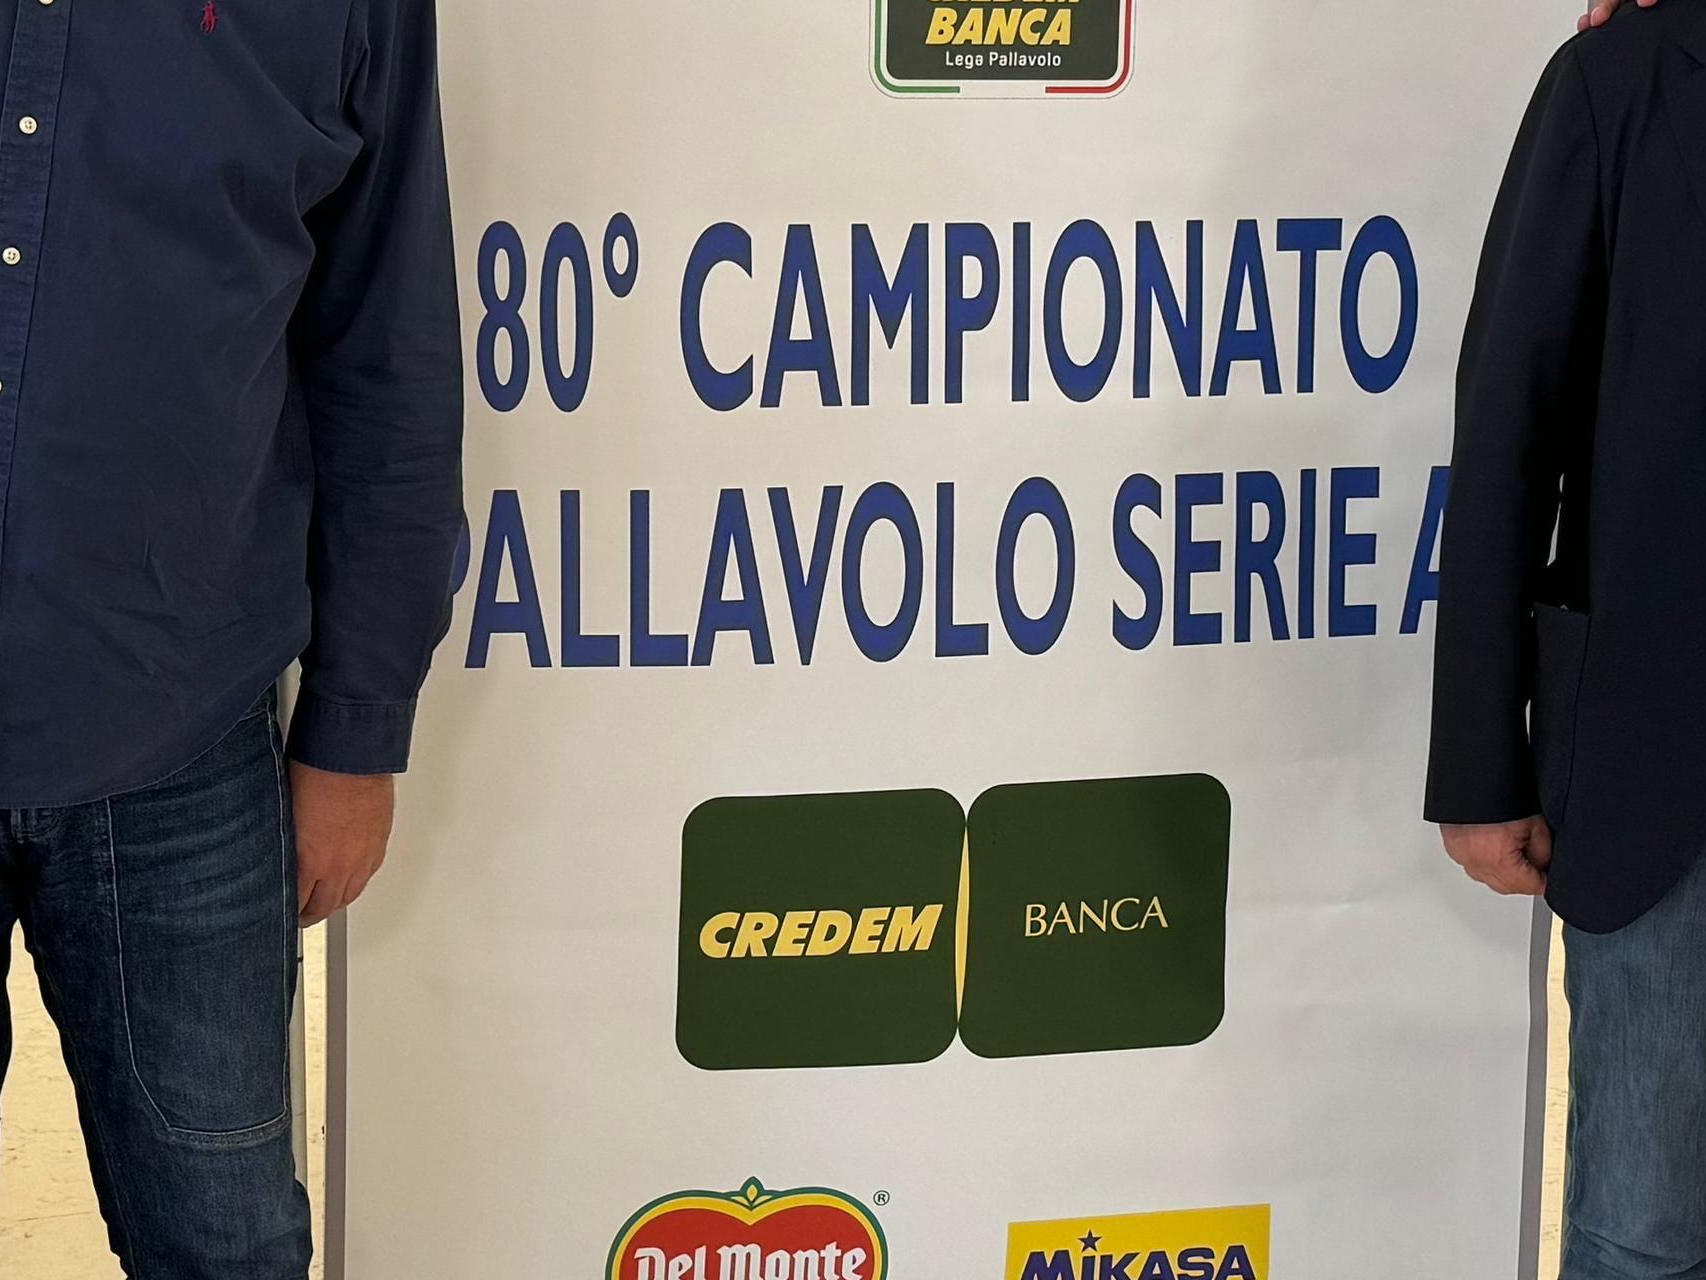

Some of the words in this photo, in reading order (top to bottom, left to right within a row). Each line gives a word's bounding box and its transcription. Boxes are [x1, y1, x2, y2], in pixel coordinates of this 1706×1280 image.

[924, 6, 1073, 46] BANCA
[945, 50, 984, 70] Lega
[989, 50, 1062, 67] Pallavolo
[679, 214, 1419, 412] CAMPIONATO
[451, 476, 1076, 669] ALLAVOLO
[1111, 466, 1381, 652] SERIE
[698, 903, 944, 959] CREDEM
[1023, 895, 1170, 938] BANCA
